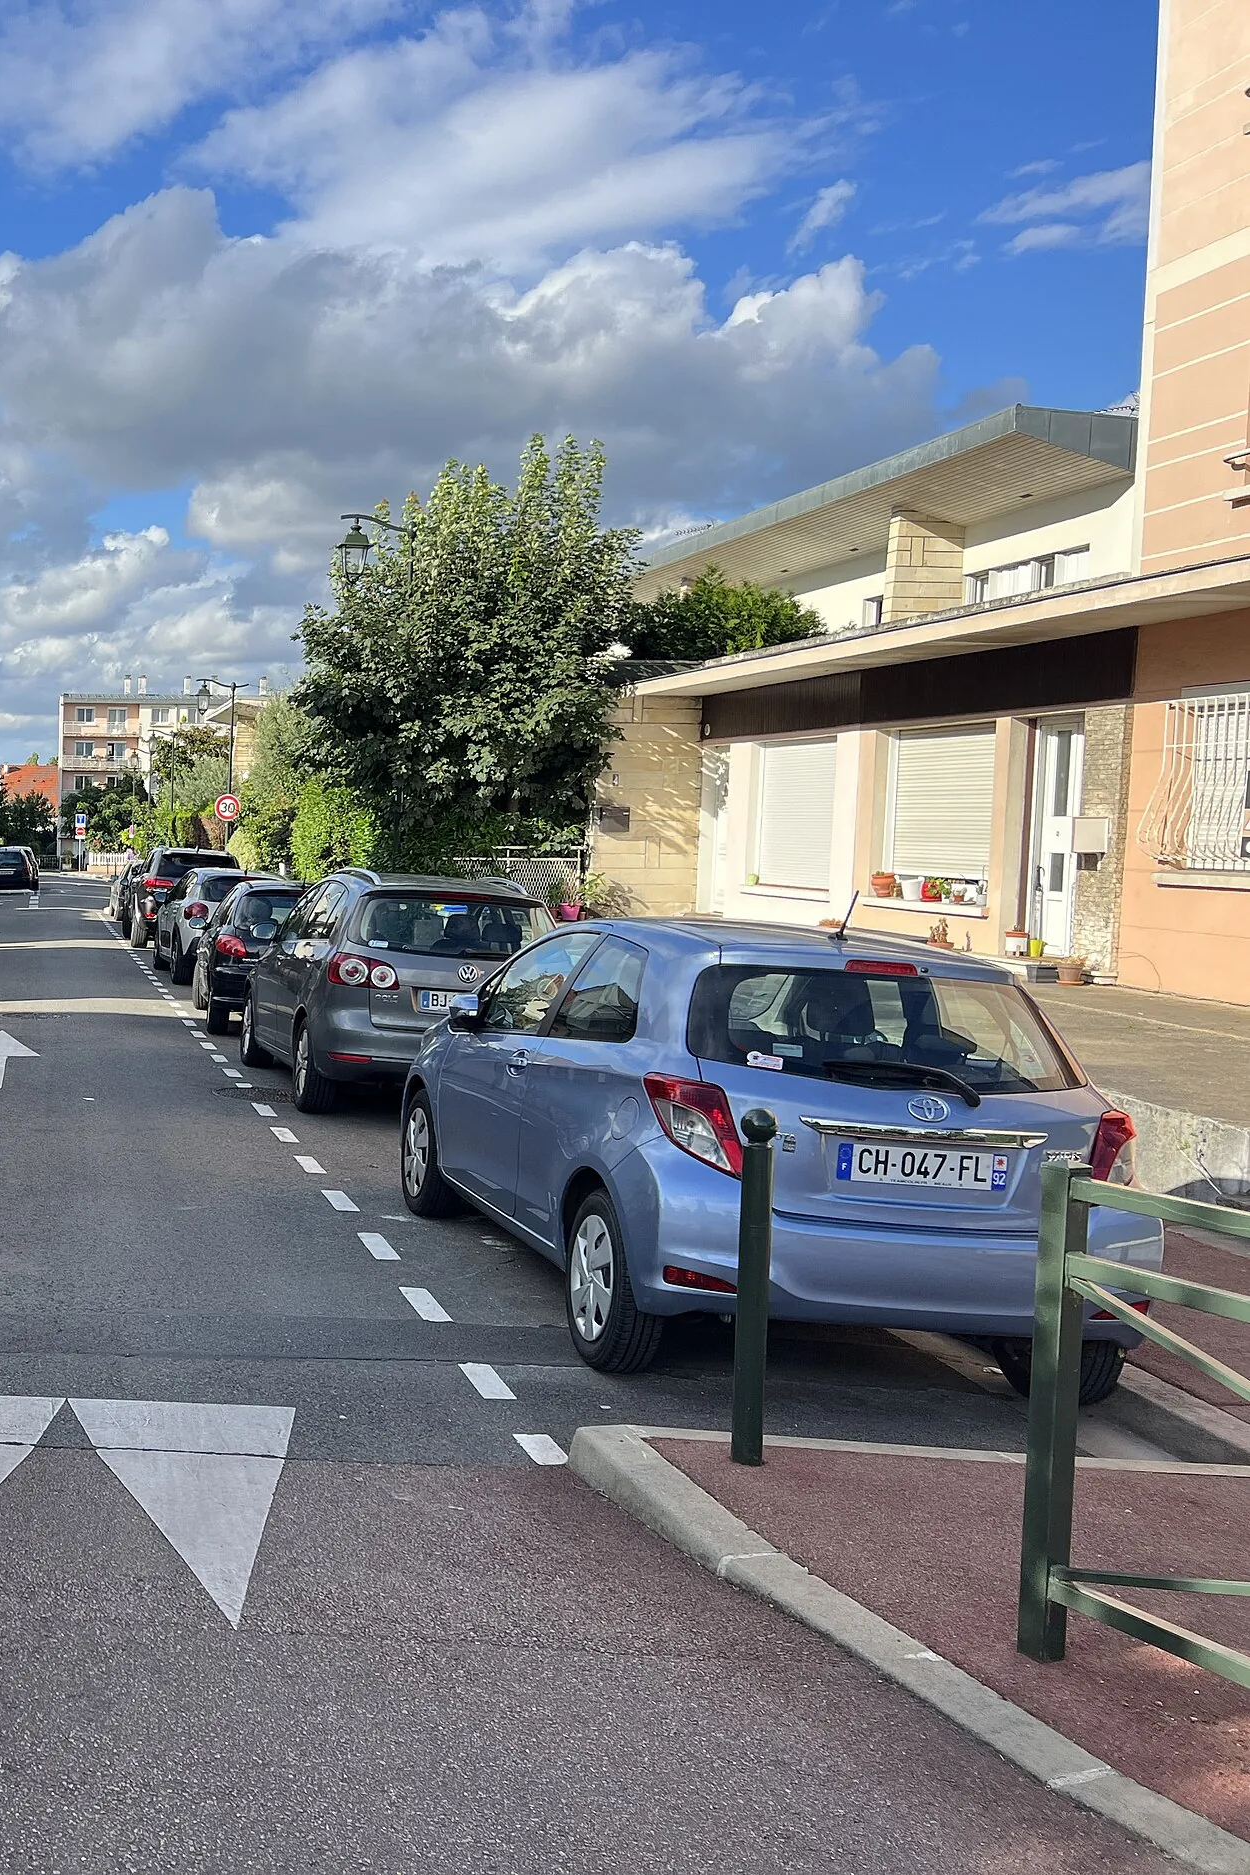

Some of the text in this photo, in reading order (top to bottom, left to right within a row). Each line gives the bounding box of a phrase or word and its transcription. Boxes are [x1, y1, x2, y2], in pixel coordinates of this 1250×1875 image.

[220, 802, 236, 813] 30
[841, 1162, 848, 1171] F
[858, 1148, 987, 1183] CH-047-FL
[992, 1172, 1007, 1186] 92
